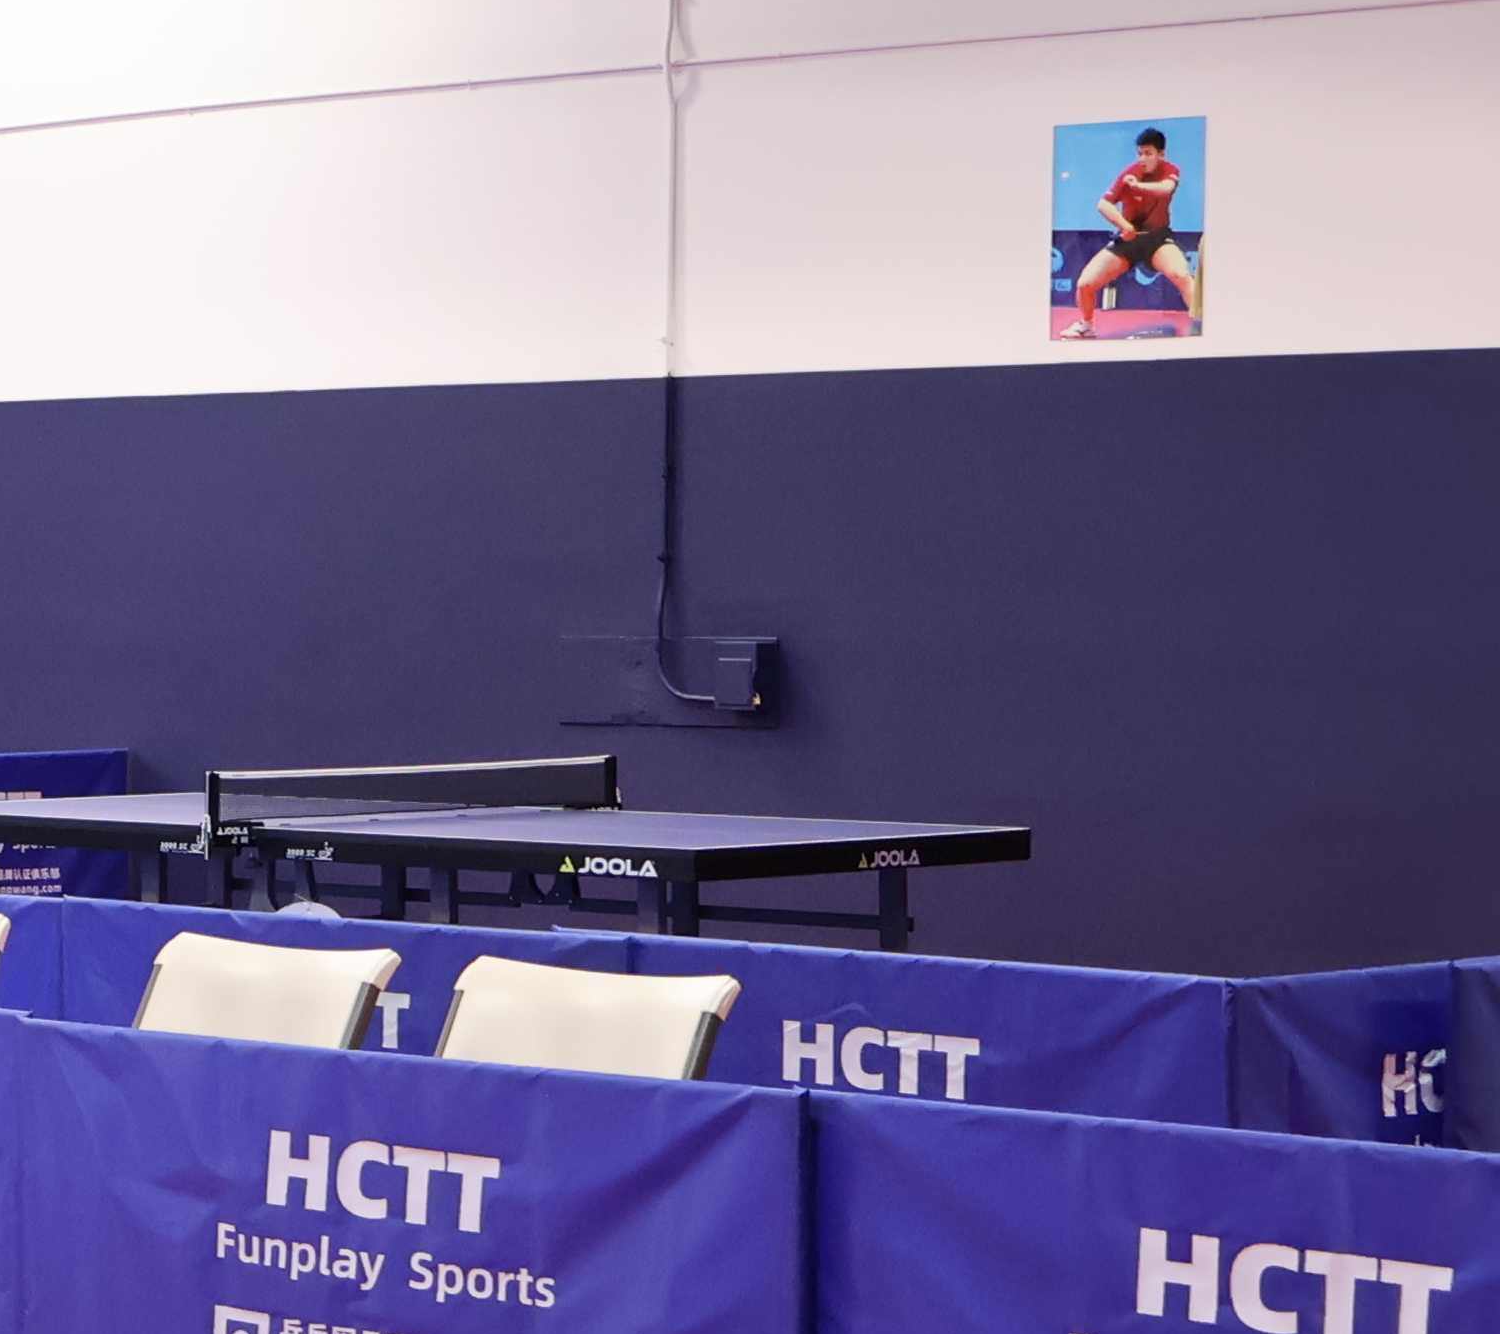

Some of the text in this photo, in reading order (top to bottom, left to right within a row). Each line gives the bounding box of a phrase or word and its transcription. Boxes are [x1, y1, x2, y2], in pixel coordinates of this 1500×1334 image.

[578, 856, 658, 877] JOOLA
[870, 848, 920, 868] JOOLA
[782, 1019, 981, 1100] HCTT
[266, 1129, 501, 1234] HCTT
[216, 1221, 556, 1308] Funplay Sports
